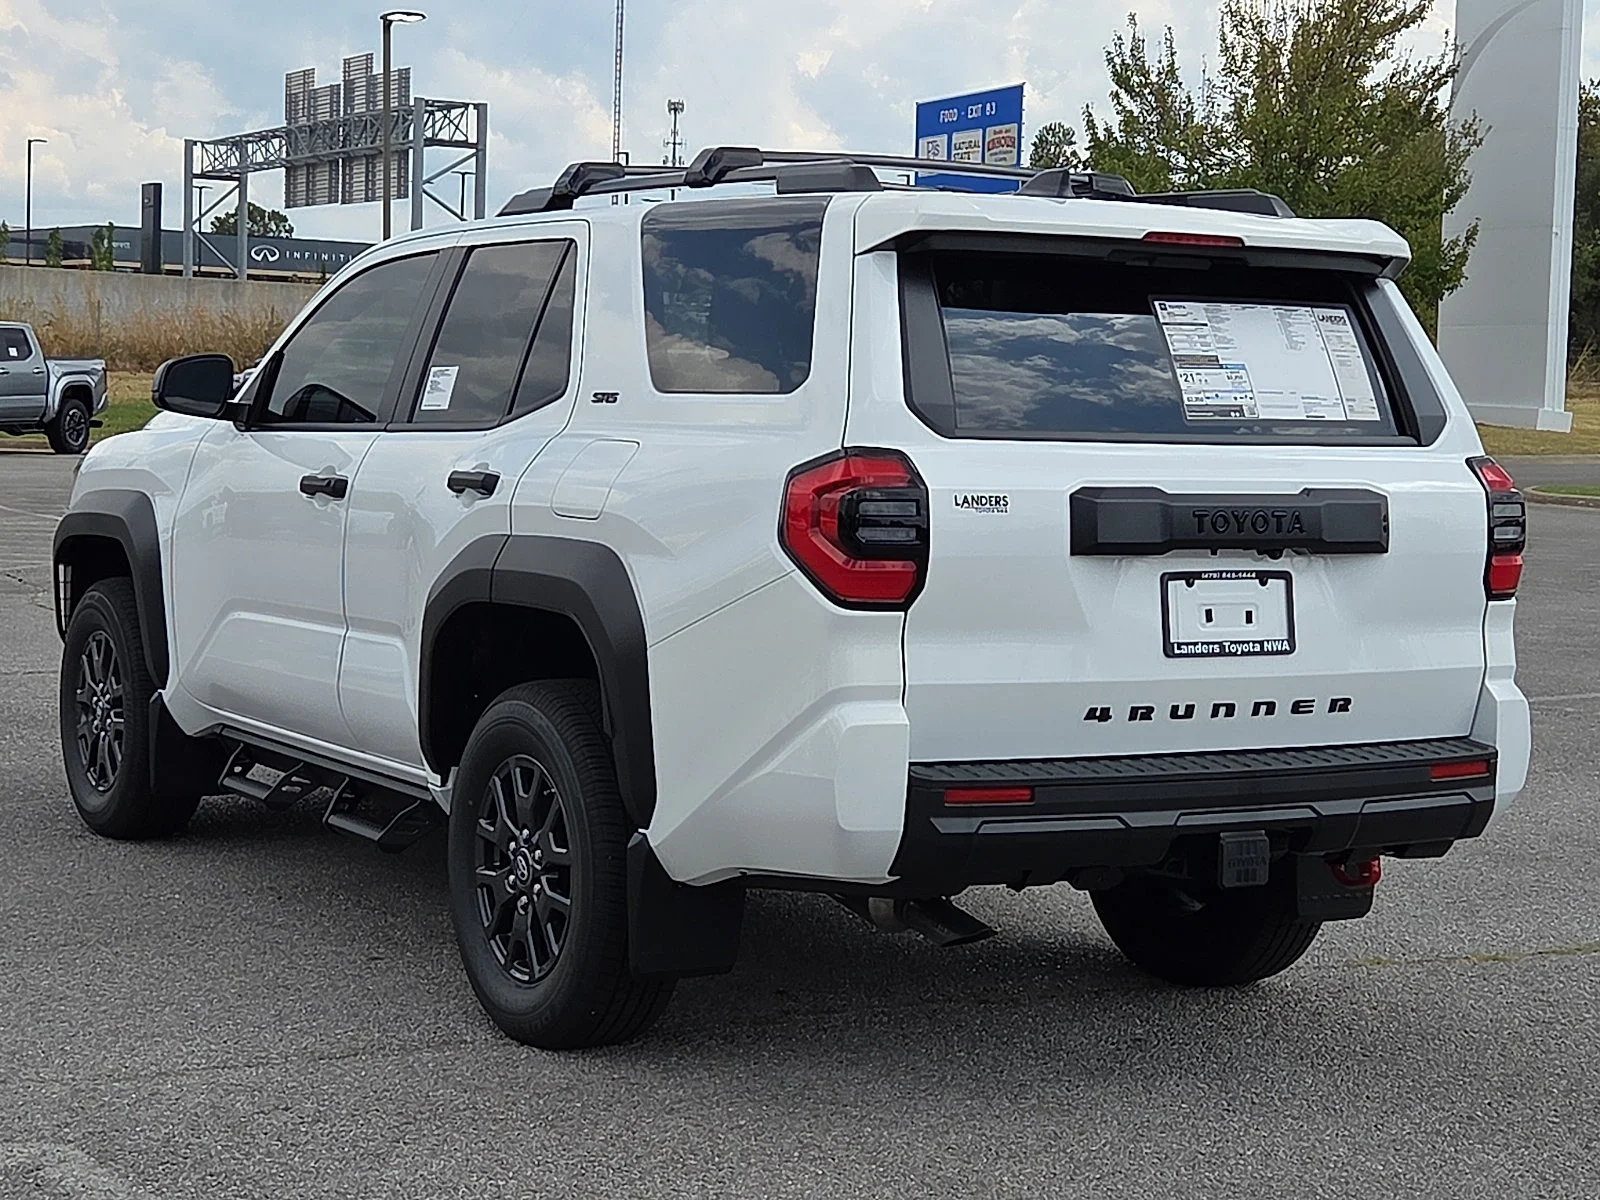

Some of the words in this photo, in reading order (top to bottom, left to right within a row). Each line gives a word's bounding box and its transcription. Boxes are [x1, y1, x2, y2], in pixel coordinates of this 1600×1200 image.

[954, 494, 1009, 508] LANDERS
[1192, 509, 1307, 534] TOYOTA
[1173, 642, 1220, 654] Landers
[1222, 641, 1261, 655] Toyota
[1263, 639, 1290, 652] NWA
[1083, 697, 1353, 723] 4RUNNER
